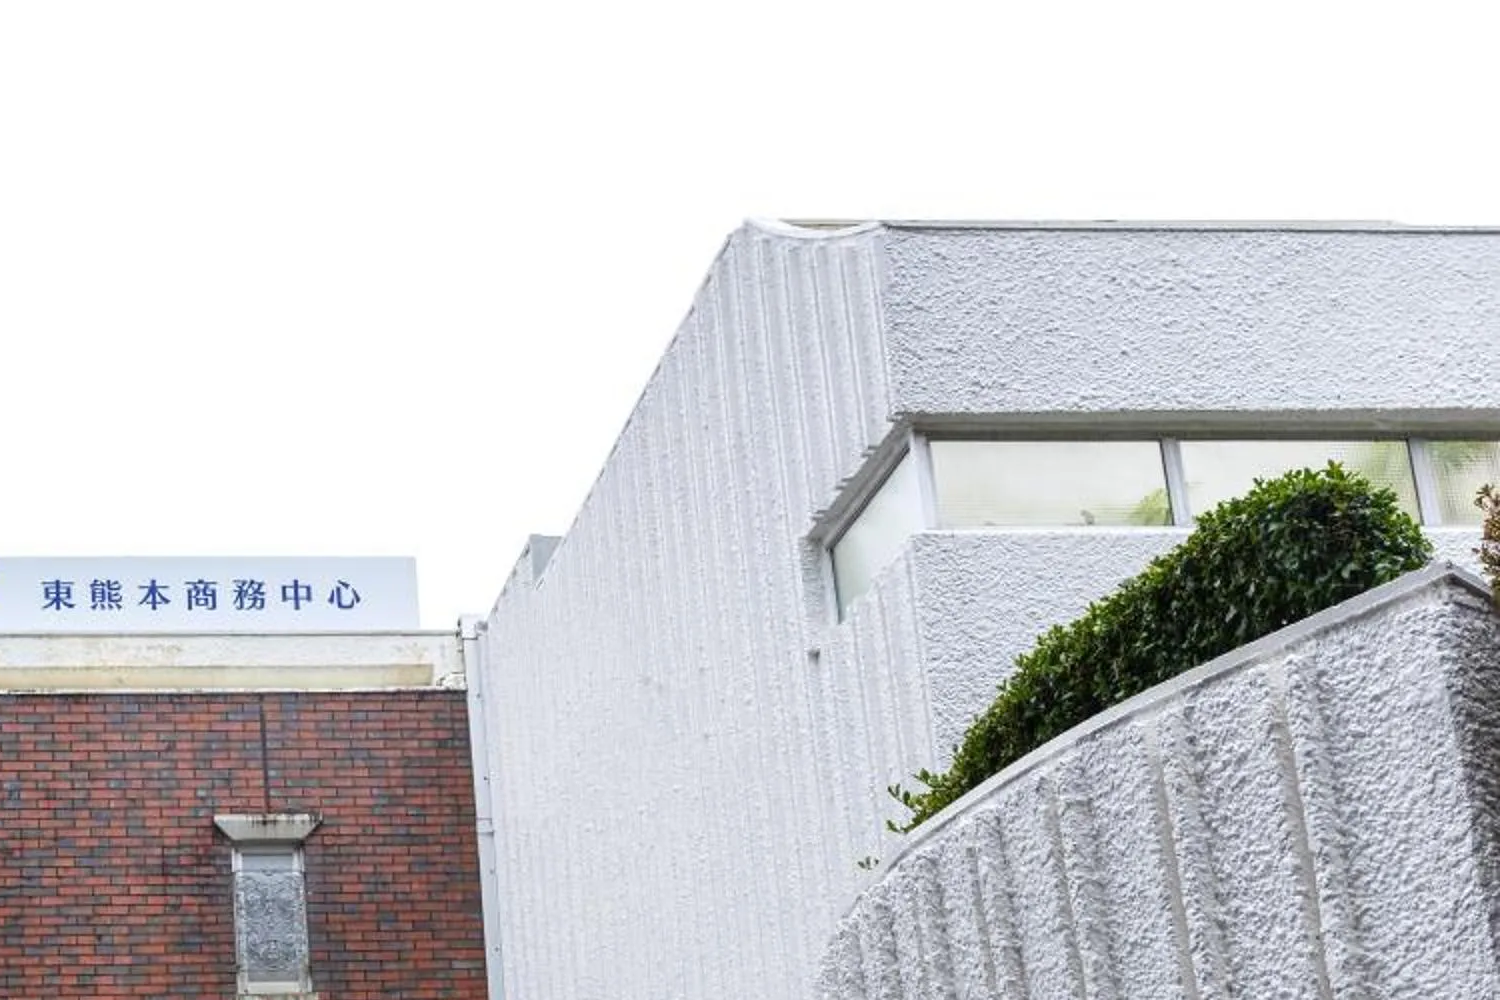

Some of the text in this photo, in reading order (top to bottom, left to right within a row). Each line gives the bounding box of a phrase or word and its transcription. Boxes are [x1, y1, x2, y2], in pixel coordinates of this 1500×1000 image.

[41, 578, 361, 611] 東熊本商務中心
